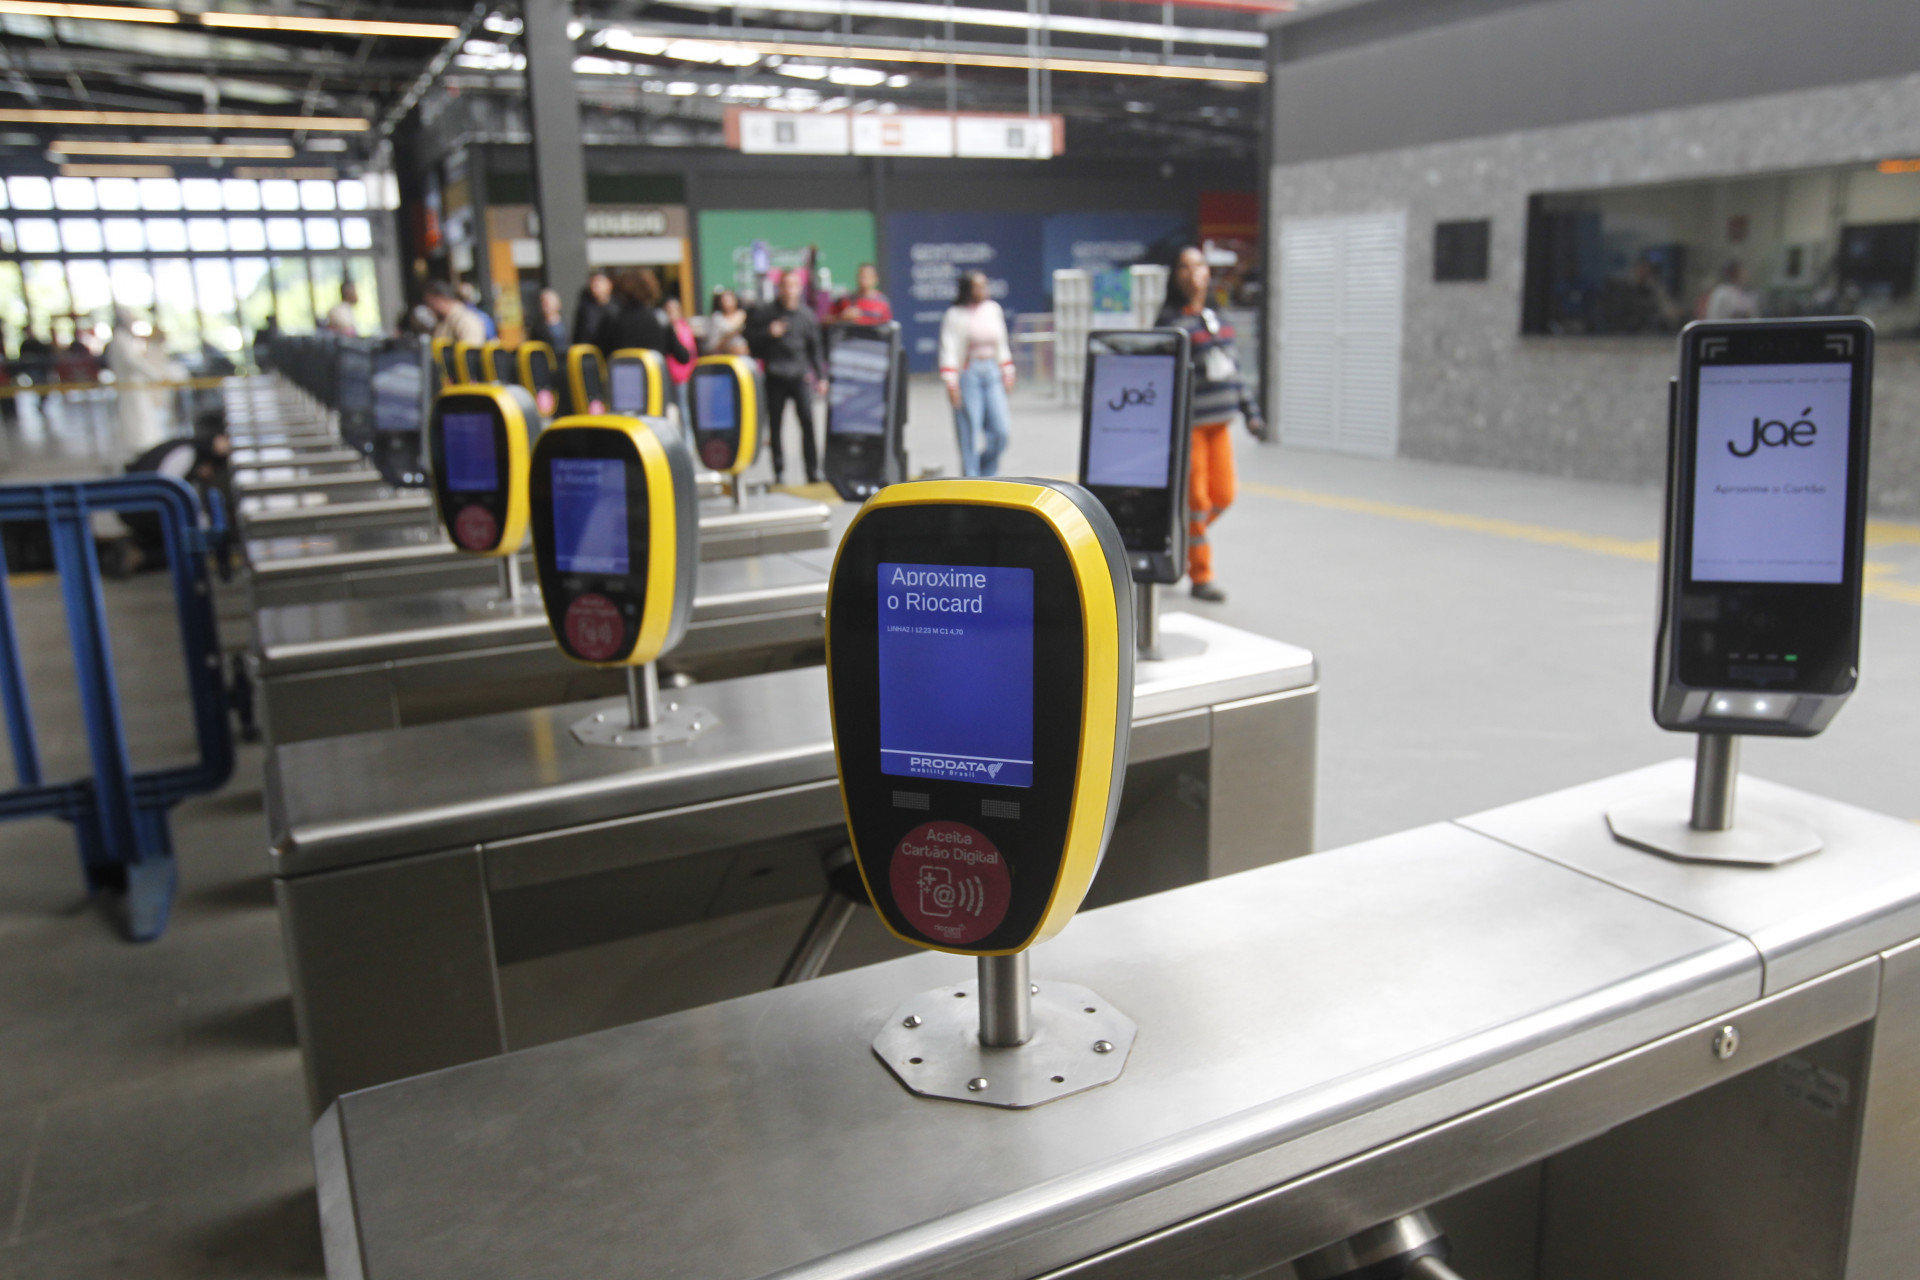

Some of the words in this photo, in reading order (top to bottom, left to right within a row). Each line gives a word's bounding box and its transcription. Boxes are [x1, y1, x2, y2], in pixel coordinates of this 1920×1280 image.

[1108, 381, 1157, 411] Jaé
[1727, 406, 1818, 458] Jaé
[1713, 483, 1769, 495] Aproxime
[1783, 482, 1827, 495] Cartão
[891, 567, 987, 589] Aproxime
[887, 594, 899, 610] o
[906, 592, 983, 614] Riocard
[887, 625, 910, 633] LINHA2
[915, 626, 932, 634] 12:23
[910, 757, 987, 773] PRODATA
[910, 767, 945, 776] mobility
[949, 769, 975, 778] Brasil
[926, 828, 973, 846] Aceita
[901, 842, 950, 860] Cartão
[953, 847, 999, 866] Digital
